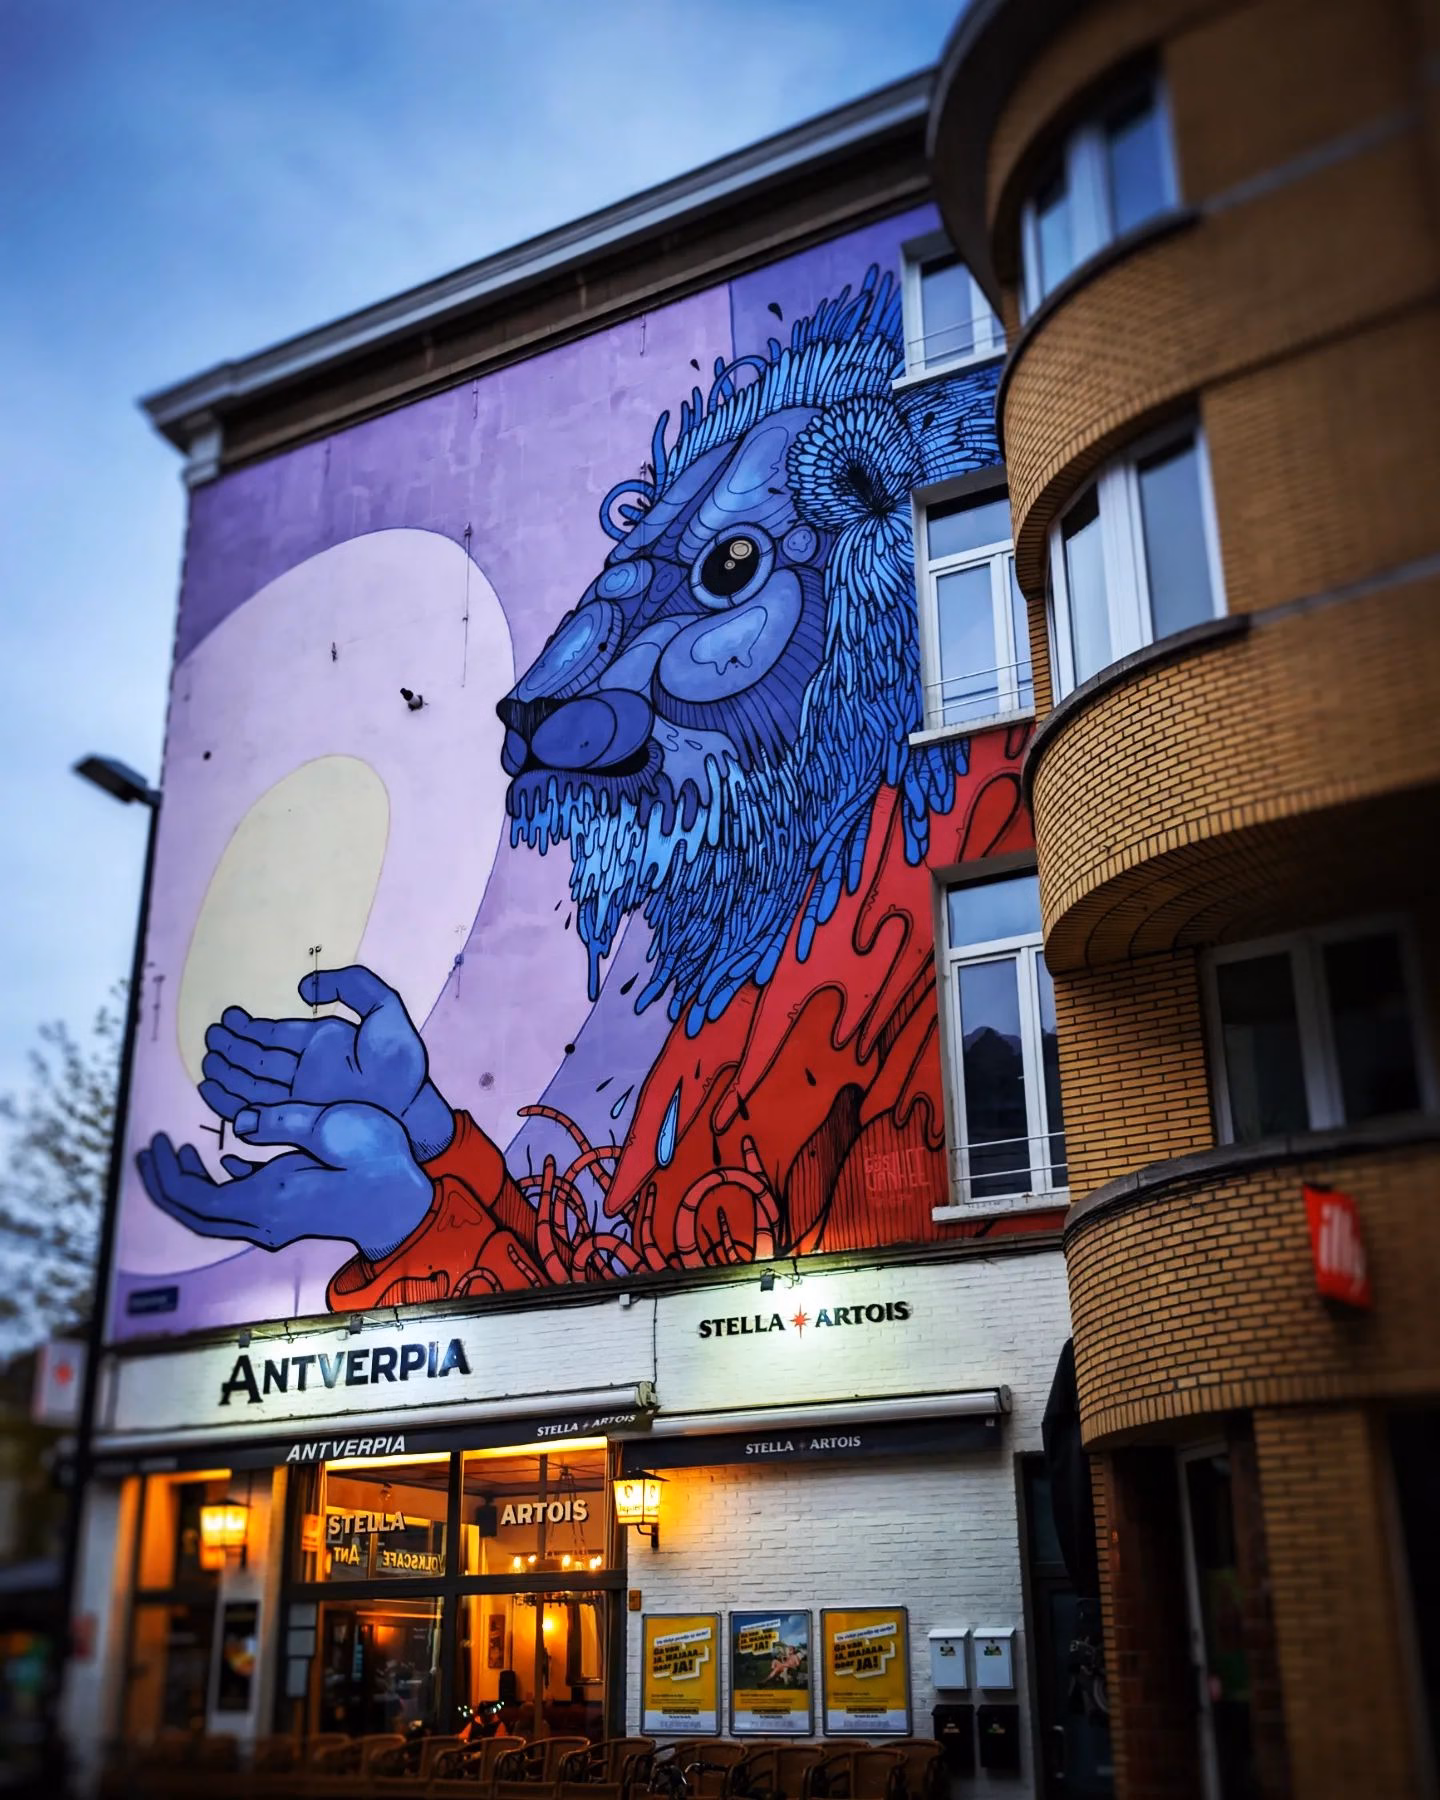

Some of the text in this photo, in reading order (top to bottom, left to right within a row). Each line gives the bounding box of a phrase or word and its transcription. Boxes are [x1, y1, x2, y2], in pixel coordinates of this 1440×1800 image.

[699, 1300, 911, 1338] STELLA ARTOIS
[219, 1338, 472, 1406] ANTVERPIA
[536, 1413, 636, 1437] STELLA ARTOIS
[286, 1435, 406, 1462] ANTVERPIA
[745, 1435, 861, 1455] STELLA ARTOIS
[328, 1511, 406, 1535] STELLA
[501, 1500, 588, 1527] ARTOIS
[847, 1641, 863, 1650] van
[653, 1659, 693, 1674] naar JA!
[834, 1655, 879, 1672] naar JA!
